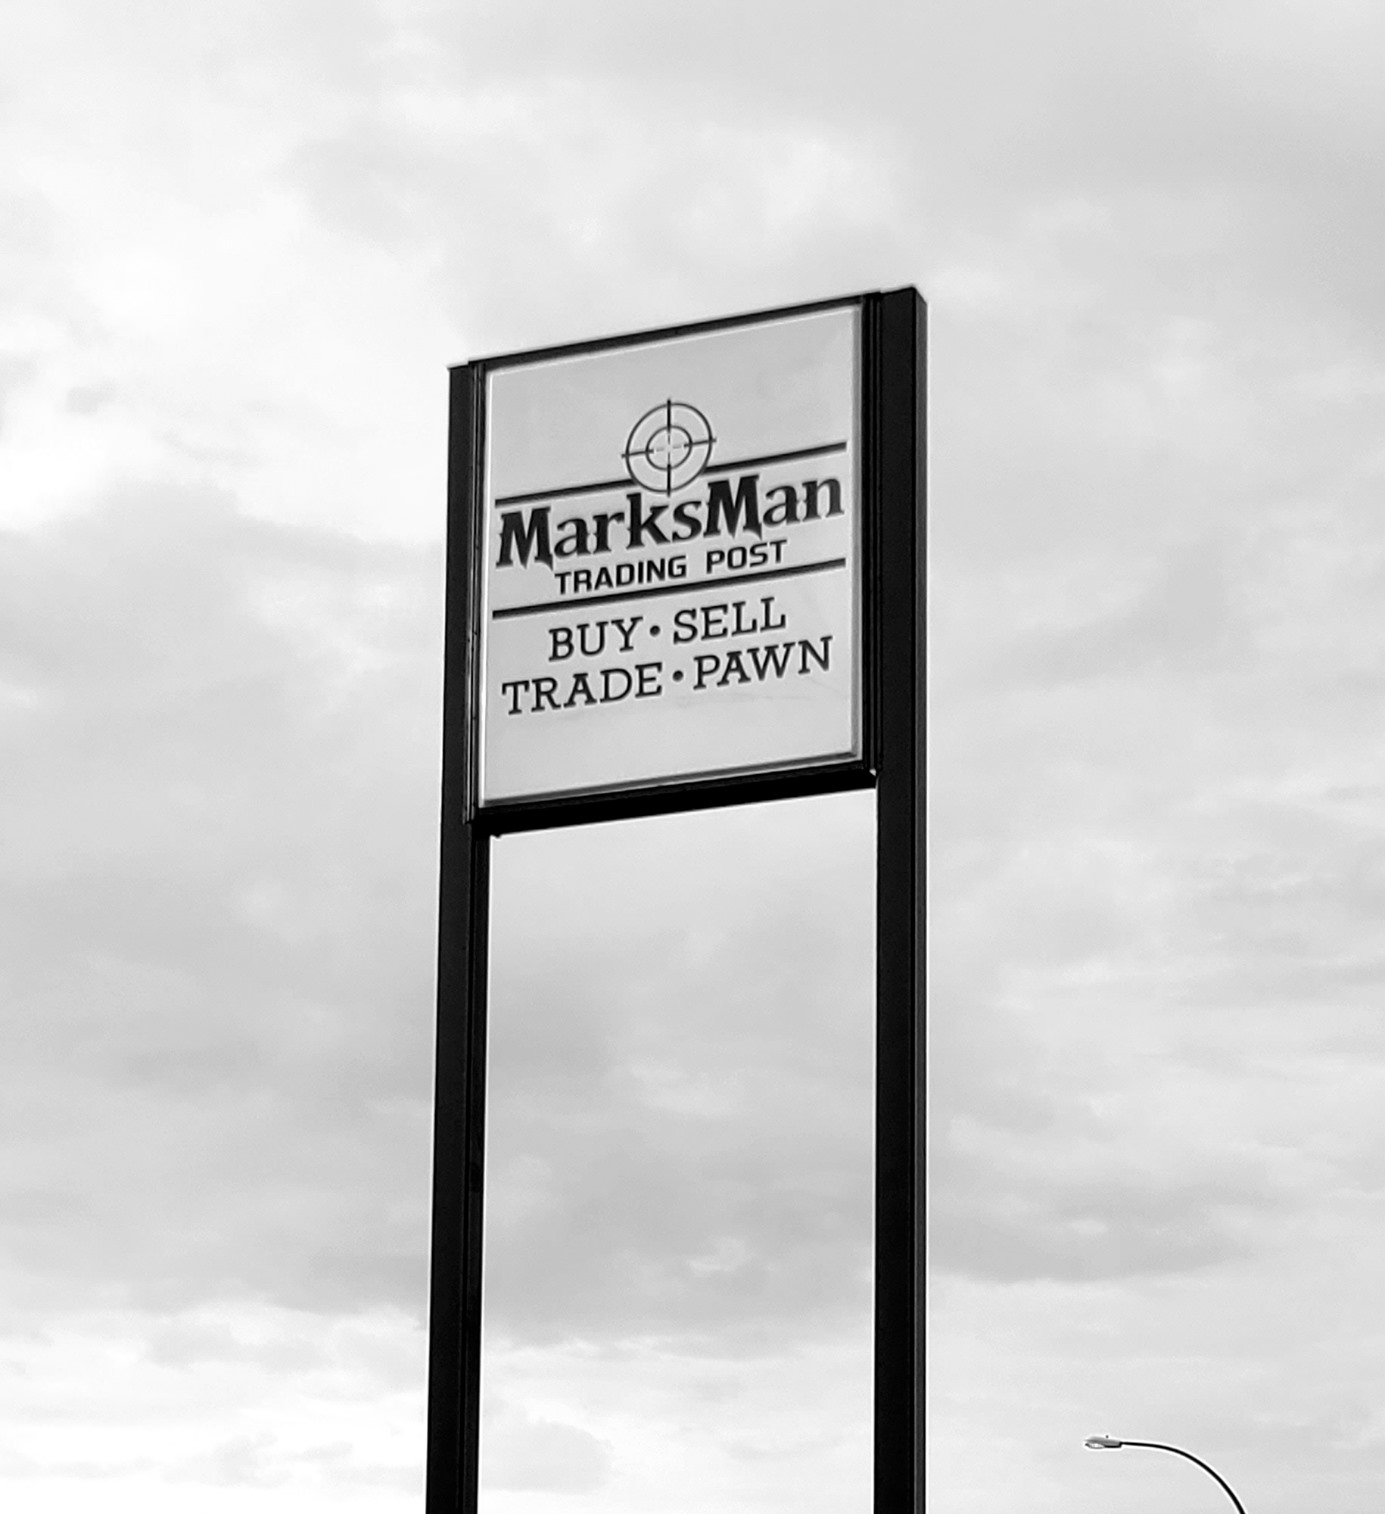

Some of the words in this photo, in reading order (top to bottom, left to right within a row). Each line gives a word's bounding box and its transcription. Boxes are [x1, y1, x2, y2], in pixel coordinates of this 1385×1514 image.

[495, 474, 844, 571] MarksMan
[554, 555, 687, 595] TRADING
[706, 539, 787, 574] POST
[548, 616, 643, 662] BUY
[673, 597, 787, 645] SELL
[502, 662, 663, 715] TRADE
[693, 635, 833, 690] PAWN
